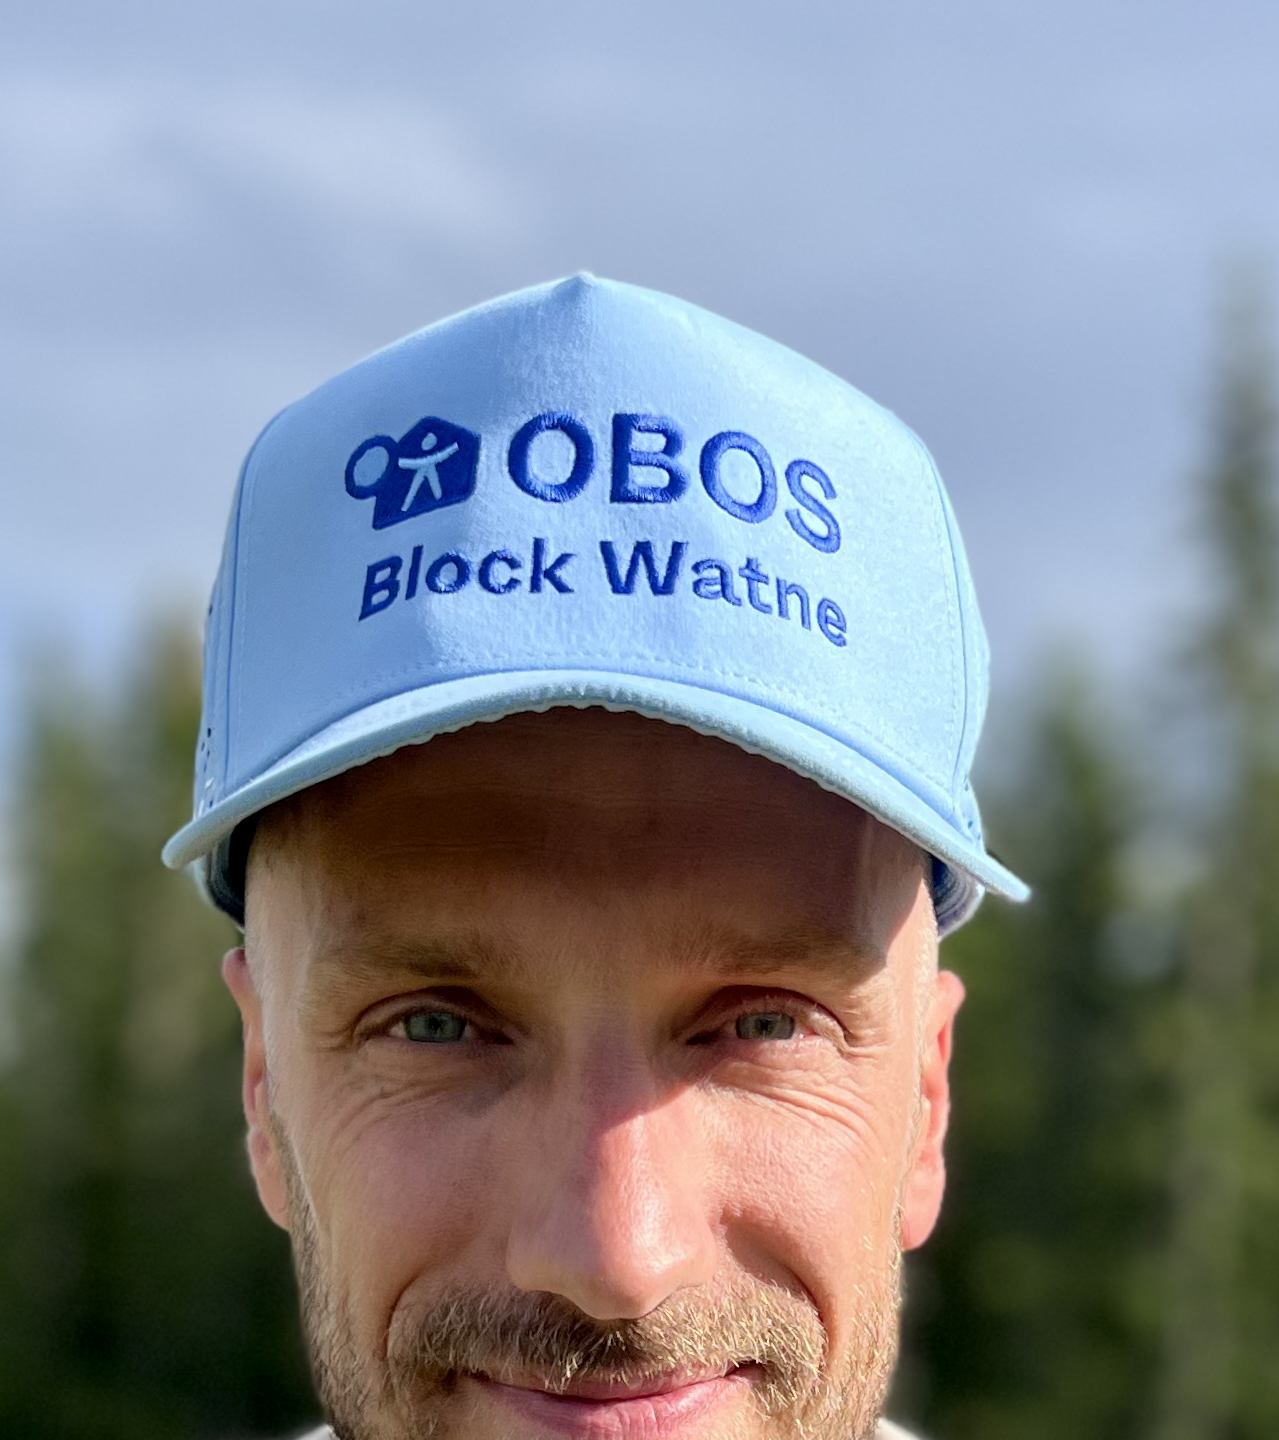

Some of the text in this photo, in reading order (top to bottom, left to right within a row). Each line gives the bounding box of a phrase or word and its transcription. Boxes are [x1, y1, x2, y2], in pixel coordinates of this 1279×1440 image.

[507, 411, 841, 553] OBOS
[358, 537, 848, 647] Block Watne
